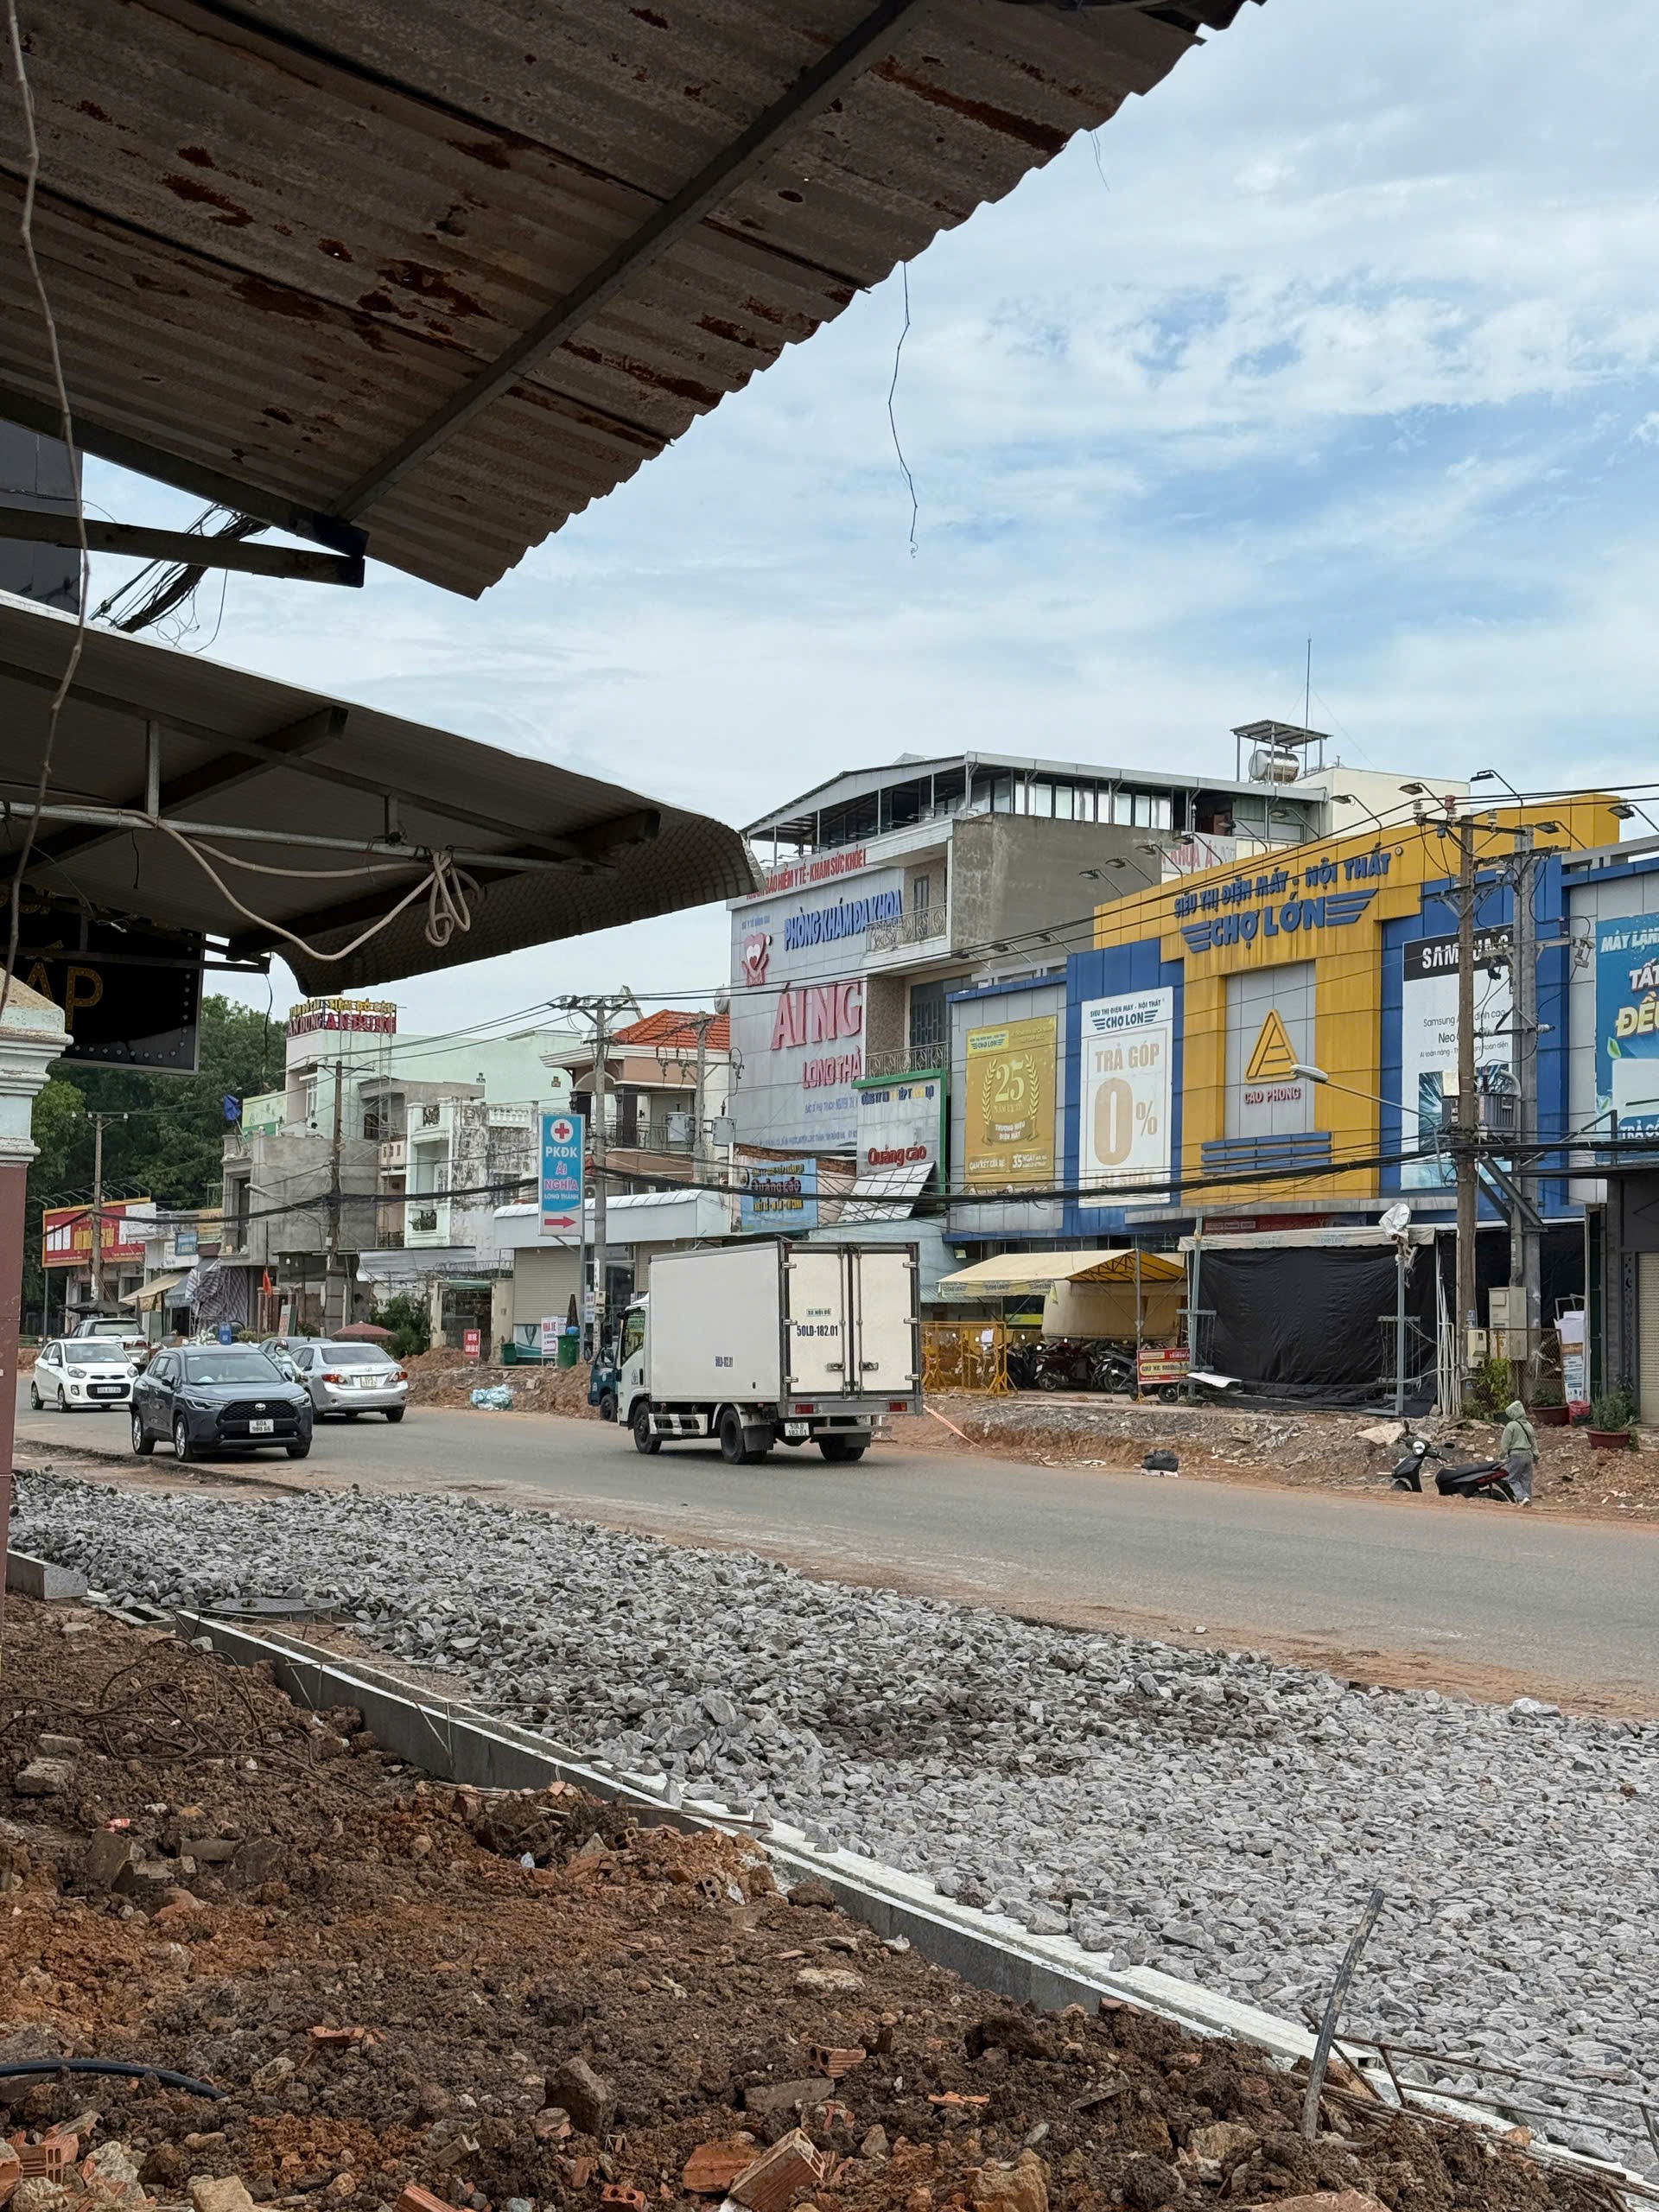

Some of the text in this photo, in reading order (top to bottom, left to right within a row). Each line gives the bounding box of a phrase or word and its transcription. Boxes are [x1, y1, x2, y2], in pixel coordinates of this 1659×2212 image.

[810, 855, 830, 882] KHÁM
[830, 851, 845, 876] SỨC
[1174, 893, 1198, 918] SIÊU
[1200, 888, 1219, 912] THỊ
[1222, 877, 1252, 906] ĐIỆN
[1255, 867, 1289, 896] MÁY
[1306, 857, 1338, 889] NỘI
[1344, 842, 1392, 880] THẤT
[785, 906, 822, 951] PHÒNG
[820, 897, 855, 943] KHÁM
[1211, 892, 1326, 950] CHỢ LỚN
[1600, 929, 1632, 953] MÁY
[1424, 1017, 1455, 1027] Samsung
[1616, 990, 1659, 1038] ĐỀ
[1439, 1033, 1455, 1044] Neo
[1095, 1040, 1160, 1072] TRẢ GÓP
[803, 1056, 836, 1090] LONG
[995, 1060, 1025, 1103] 25
[1244, 1087, 1301, 1105] CAO PHONG
[545, 1146, 578, 1158] PKĐK
[868, 1141, 927, 1166] Quảng cáo
[543, 1176, 579, 1191] NGHĨA
[797, 1325, 838, 1337] 50LD-182.01
